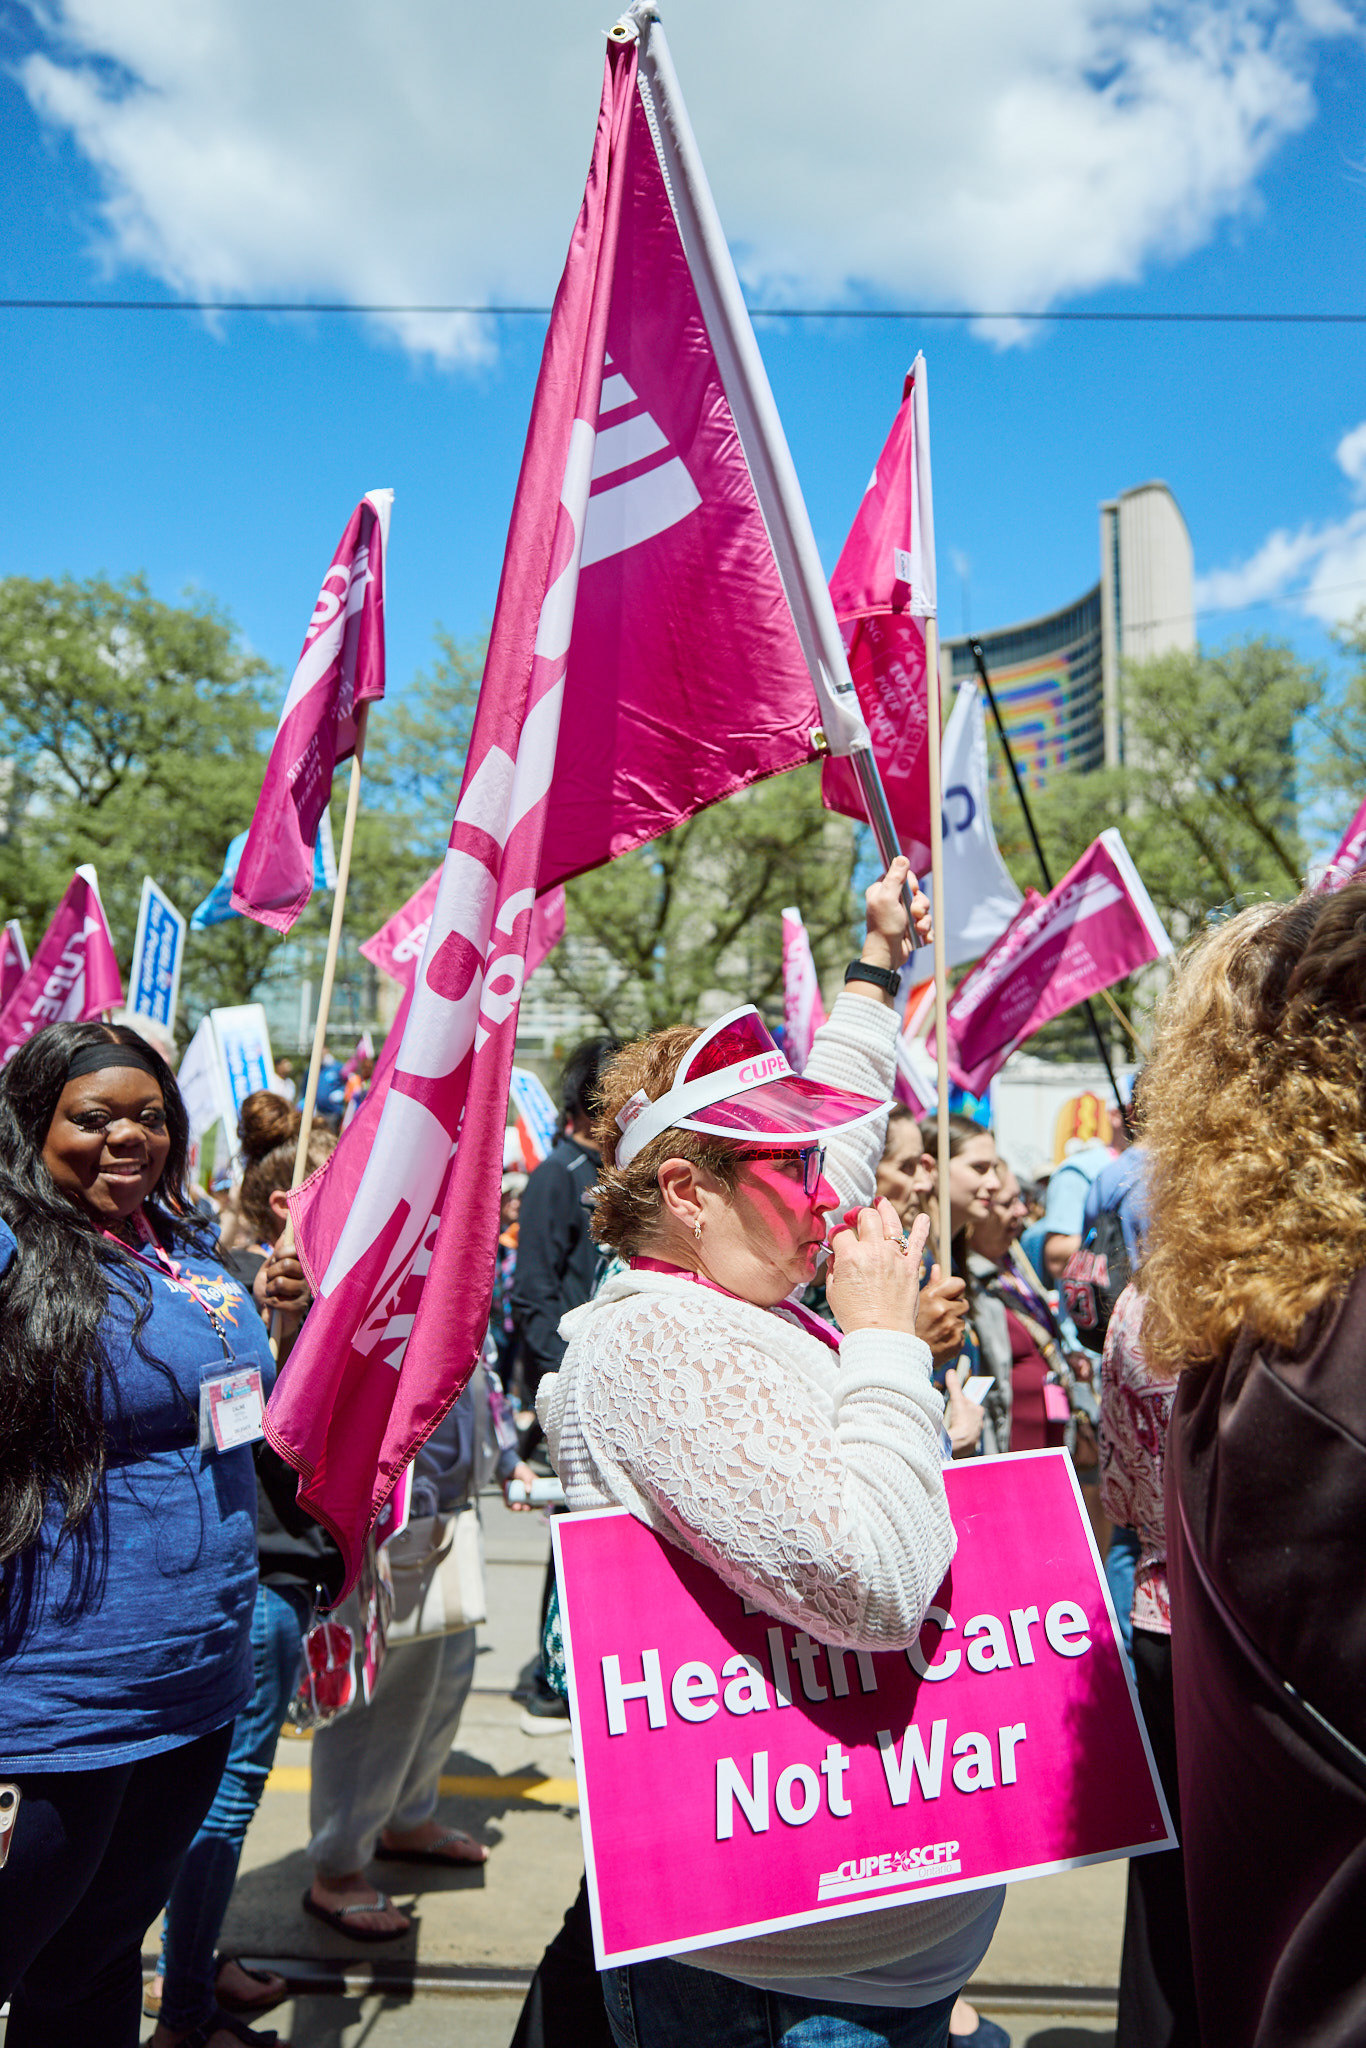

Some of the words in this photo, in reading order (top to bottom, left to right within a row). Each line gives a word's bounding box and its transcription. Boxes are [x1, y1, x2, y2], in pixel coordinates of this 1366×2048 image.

[738, 1055, 786, 1084] CUPE
[601, 1626, 878, 1736] Health
[904, 1600, 1093, 1682] Care
[716, 1742, 853, 1840] Not
[876, 1718, 1027, 1806] War
[836, 1853, 893, 1882] CUPE
[908, 1840, 960, 1869] SCFP
[918, 1865, 953, 1879] Ontario
